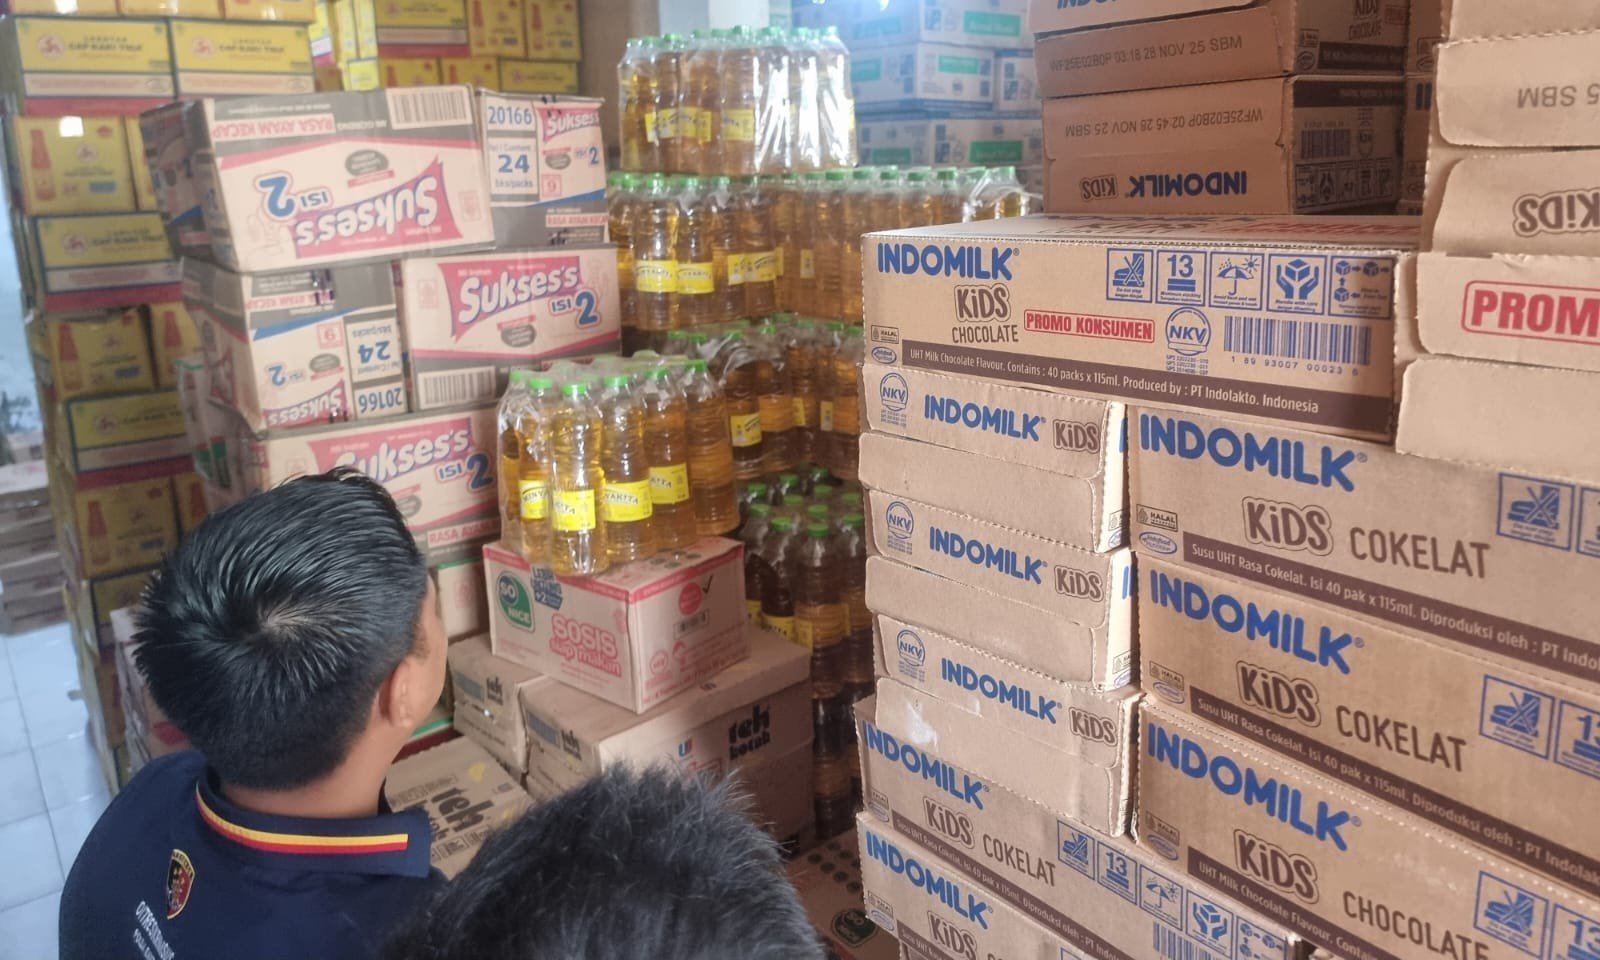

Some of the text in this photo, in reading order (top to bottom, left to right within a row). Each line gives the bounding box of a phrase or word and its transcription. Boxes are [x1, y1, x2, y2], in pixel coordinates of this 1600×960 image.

[1159, 43, 1185, 58] NOV
[1189, 40, 1206, 54] 25
[1209, 35, 1242, 52] SBM
[1516, 84, 1577, 109] SBM
[213, 117, 334, 139] RASA AYAM KECAP
[488, 105, 533, 125] 20166
[1065, 123, 1092, 138] SBM
[1094, 122, 1109, 136] 25
[1111, 120, 1138, 135] NOV
[1141, 118, 1153, 132] 28
[498, 154, 530, 174] 24
[588, 146, 600, 166] 2
[259, 175, 295, 217] 2
[300, 191, 329, 209] ISI
[1129, 170, 1248, 199] INDOMILK
[296, 175, 438, 245] Sukses's
[877, 242, 1013, 281] INDOMILK
[1167, 254, 1194, 278] 13
[458, 266, 579, 324] Sukses's
[551, 298, 572, 313] ISI
[576, 291, 599, 325] 2
[957, 287, 1009, 320] KiDS
[952, 324, 1019, 344] CHOCOLATE
[1026, 312, 1153, 341] PROMO KONSUMEN
[1169, 325, 1208, 344] NKV
[358, 340, 391, 364] 24
[268, 364, 286, 387] 2
[910, 348, 925, 359] UHT
[925, 350, 939, 362] Milk
[940, 352, 975, 367] Chocolate
[976, 356, 1006, 371] Flavour.
[1007, 361, 1041, 377] Contains
[1047, 366, 1059, 378] 40
[1060, 368, 1085, 383] packs
[1086, 374, 1092, 383] x
[1123, 375, 1167, 393] Produced
[1169, 381, 1182, 396] by
[1190, 384, 1204, 397] PT
[1205, 386, 1260, 406] Indolakto.
[1262, 393, 1320, 414] Indonesia
[358, 387, 403, 414] 20166
[882, 386, 906, 403] NKV
[924, 393, 1040, 442] INDOMILK
[1055, 422, 1099, 451] KiDS
[1140, 413, 1356, 493] INDOMILK
[439, 463, 463, 479] ISI
[467, 453, 494, 489] 2
[888, 513, 912, 531] NKV
[1149, 510, 1176, 523] HALAL
[1247, 501, 1328, 551] KiDS
[929, 526, 1042, 585] INDOMILK
[1057, 567, 1102, 600] KiDS
[1350, 526, 1492, 579] COKELAT
[1192, 543, 1216, 559] Susu
[1216, 547, 1237, 565] UHT
[1238, 559, 1263, 574] Rasa
[1264, 564, 1307, 587] Cokelat.
[1310, 576, 1323, 591] Isi
[1325, 581, 1341, 596] 40
[1343, 585, 1366, 602] pak
[1369, 597, 1376, 606] x
[1421, 606, 1494, 640] Diproduksi
[1496, 630, 1529, 651] oleh
[1541, 641, 1560, 660] PT
[552, 613, 618, 660] SOSIS
[1150, 568, 1353, 675] INDOMILK
[900, 641, 923, 662] NKV
[941, 657, 1117, 744] INDOMILK KiDS
[1240, 665, 1316, 723] KiDS
[1335, 705, 1468, 773] COKELAT
[862, 720, 985, 811] INDOMILK
[1198, 698, 1219, 717] Susu
[1220, 704, 1239, 722] UHT
[1240, 716, 1264, 737] Rasa
[1308, 744, 1322, 759] Isi
[1323, 752, 1338, 769] 40
[1340, 760, 1362, 780] pak
[1363, 774, 1371, 784] x
[1412, 791, 1481, 834] Diproduksi
[1483, 826, 1513, 848] oleh
[1524, 841, 1542, 861] PT
[1147, 722, 1351, 852] INDOMILK
[925, 798, 974, 845] KiDS
[982, 833, 1056, 887] COKELAT
[1106, 850, 1128, 877] 13
[1238, 833, 1315, 900] KiDS
[865, 831, 989, 931] INDOMILK
[1199, 860, 1217, 880] UHT
[1218, 872, 1240, 892] Milk
[1240, 884, 1290, 919] Chocolate
[1062, 920, 1080, 940] oleh
